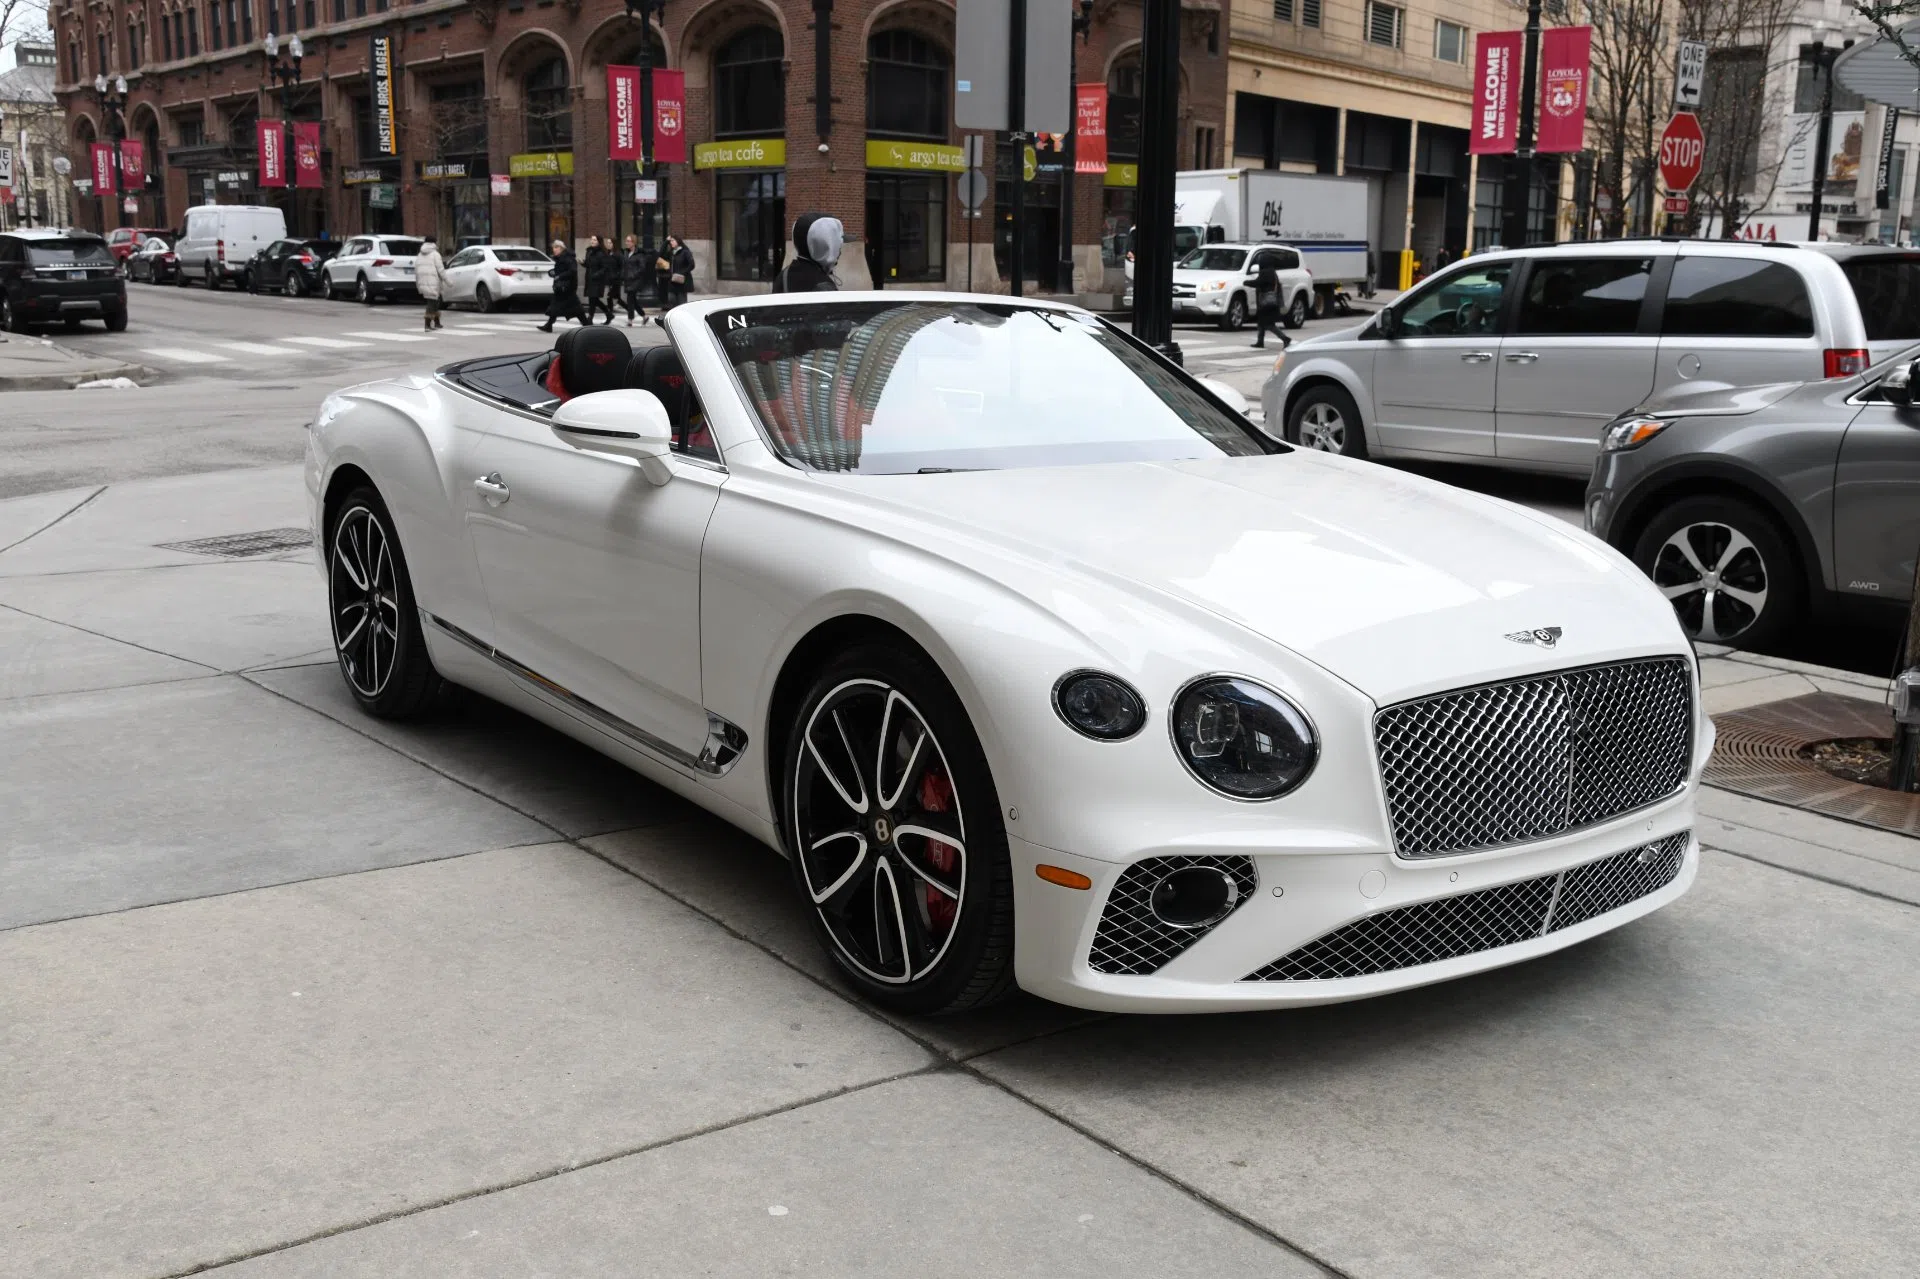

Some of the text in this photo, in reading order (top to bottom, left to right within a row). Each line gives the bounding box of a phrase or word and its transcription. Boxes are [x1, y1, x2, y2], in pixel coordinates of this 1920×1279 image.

[1684, 46, 1703, 63] ONE
[1547, 68, 1582, 77] LOYOLA
[1681, 63, 1701, 80] WAY
[375, 38, 391, 152] EINSTEIN BROS. BAGELS
[657, 100, 681, 108] LOYOLA
[1482, 47, 1501, 139] WELCOME
[1497, 47, 1509, 139] WATER TOWER CAMPUS
[616, 77, 627, 148] WELCOME
[1079, 108, 1100, 117] David
[1087, 117, 1100, 126] Lee
[264, 129, 274, 179] WELCOME
[736, 141, 764, 161] café
[910, 152, 935, 167] argo
[937, 151, 950, 165] tea
[1662, 137, 1700, 168] STOP
[1877, 107, 1895, 191] ORDSTROM rack
[1262, 200, 1283, 226] Abt
[1848, 580, 1880, 591] AWD
[874, 818, 890, 842] B
